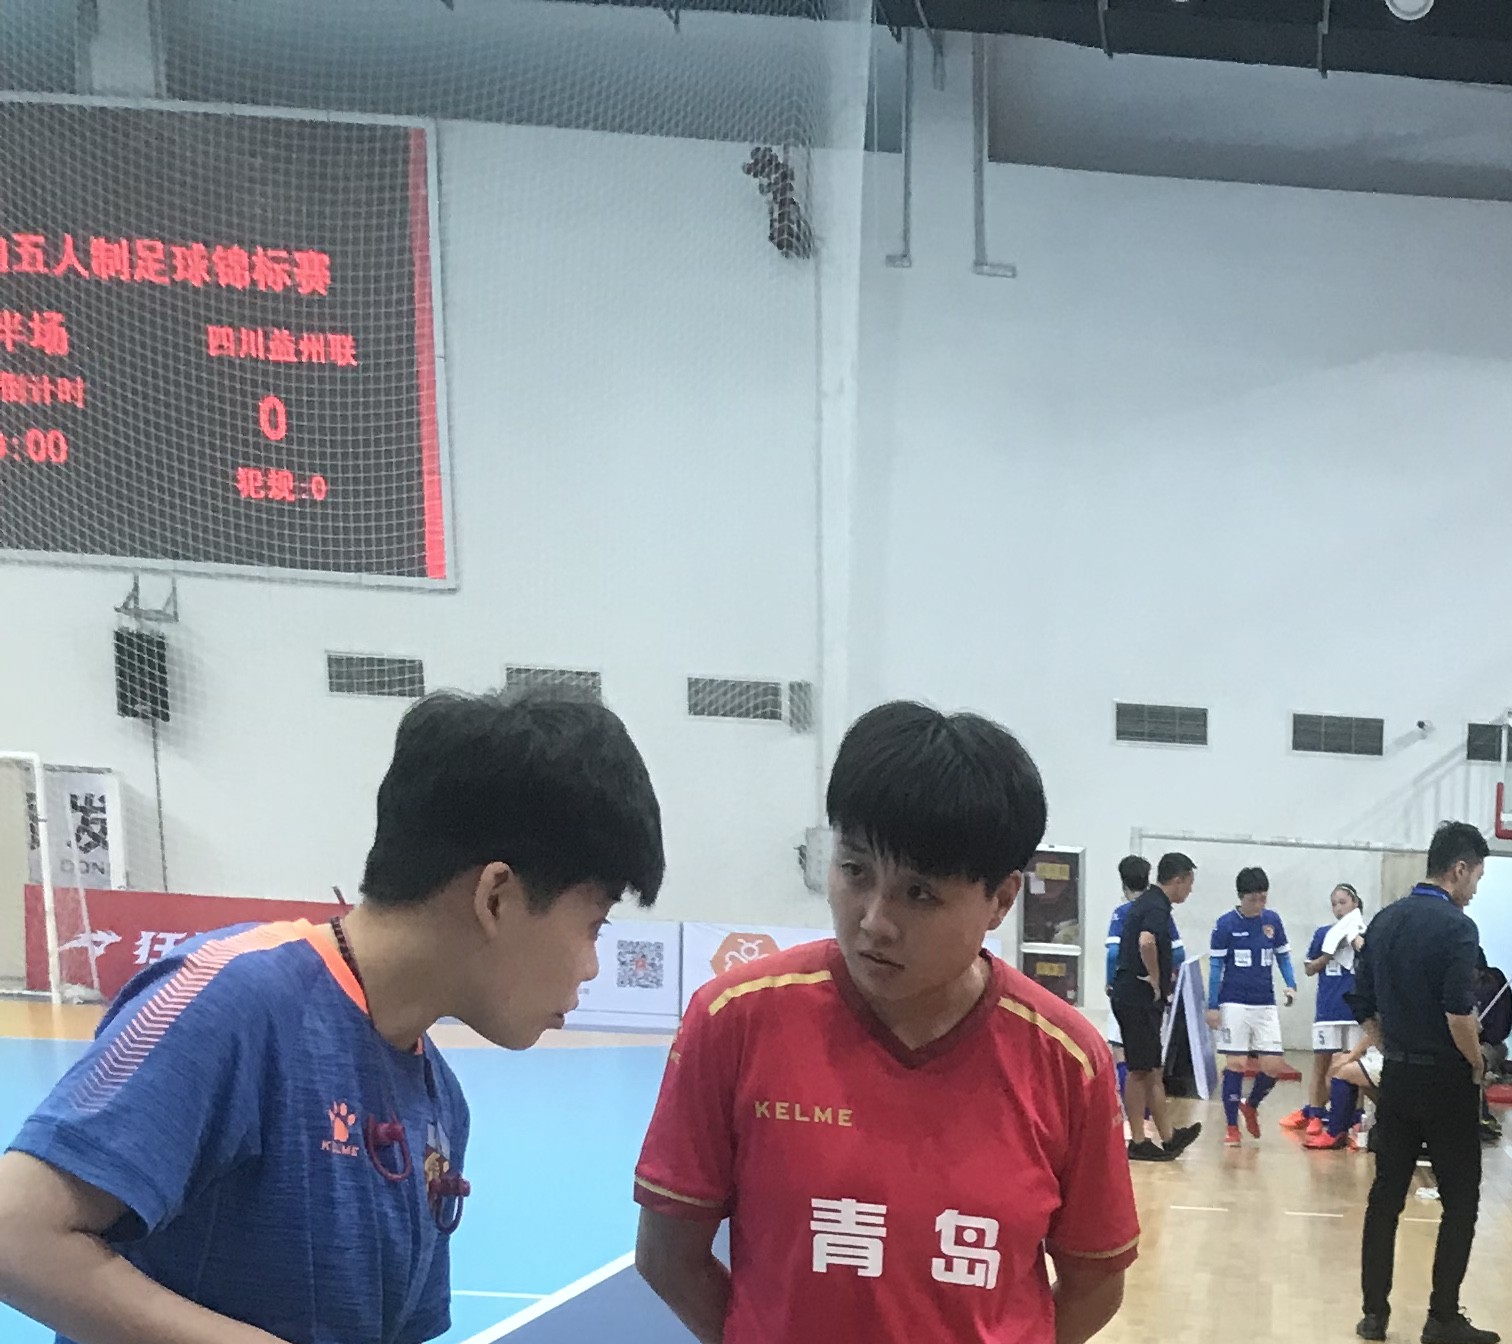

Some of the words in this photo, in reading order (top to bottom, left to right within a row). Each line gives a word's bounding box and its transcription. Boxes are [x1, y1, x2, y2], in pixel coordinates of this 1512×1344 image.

[258, 396, 288, 441] 0
[754, 1100, 854, 1127] KELME
[810, 1198, 1000, 1290] 青岛
